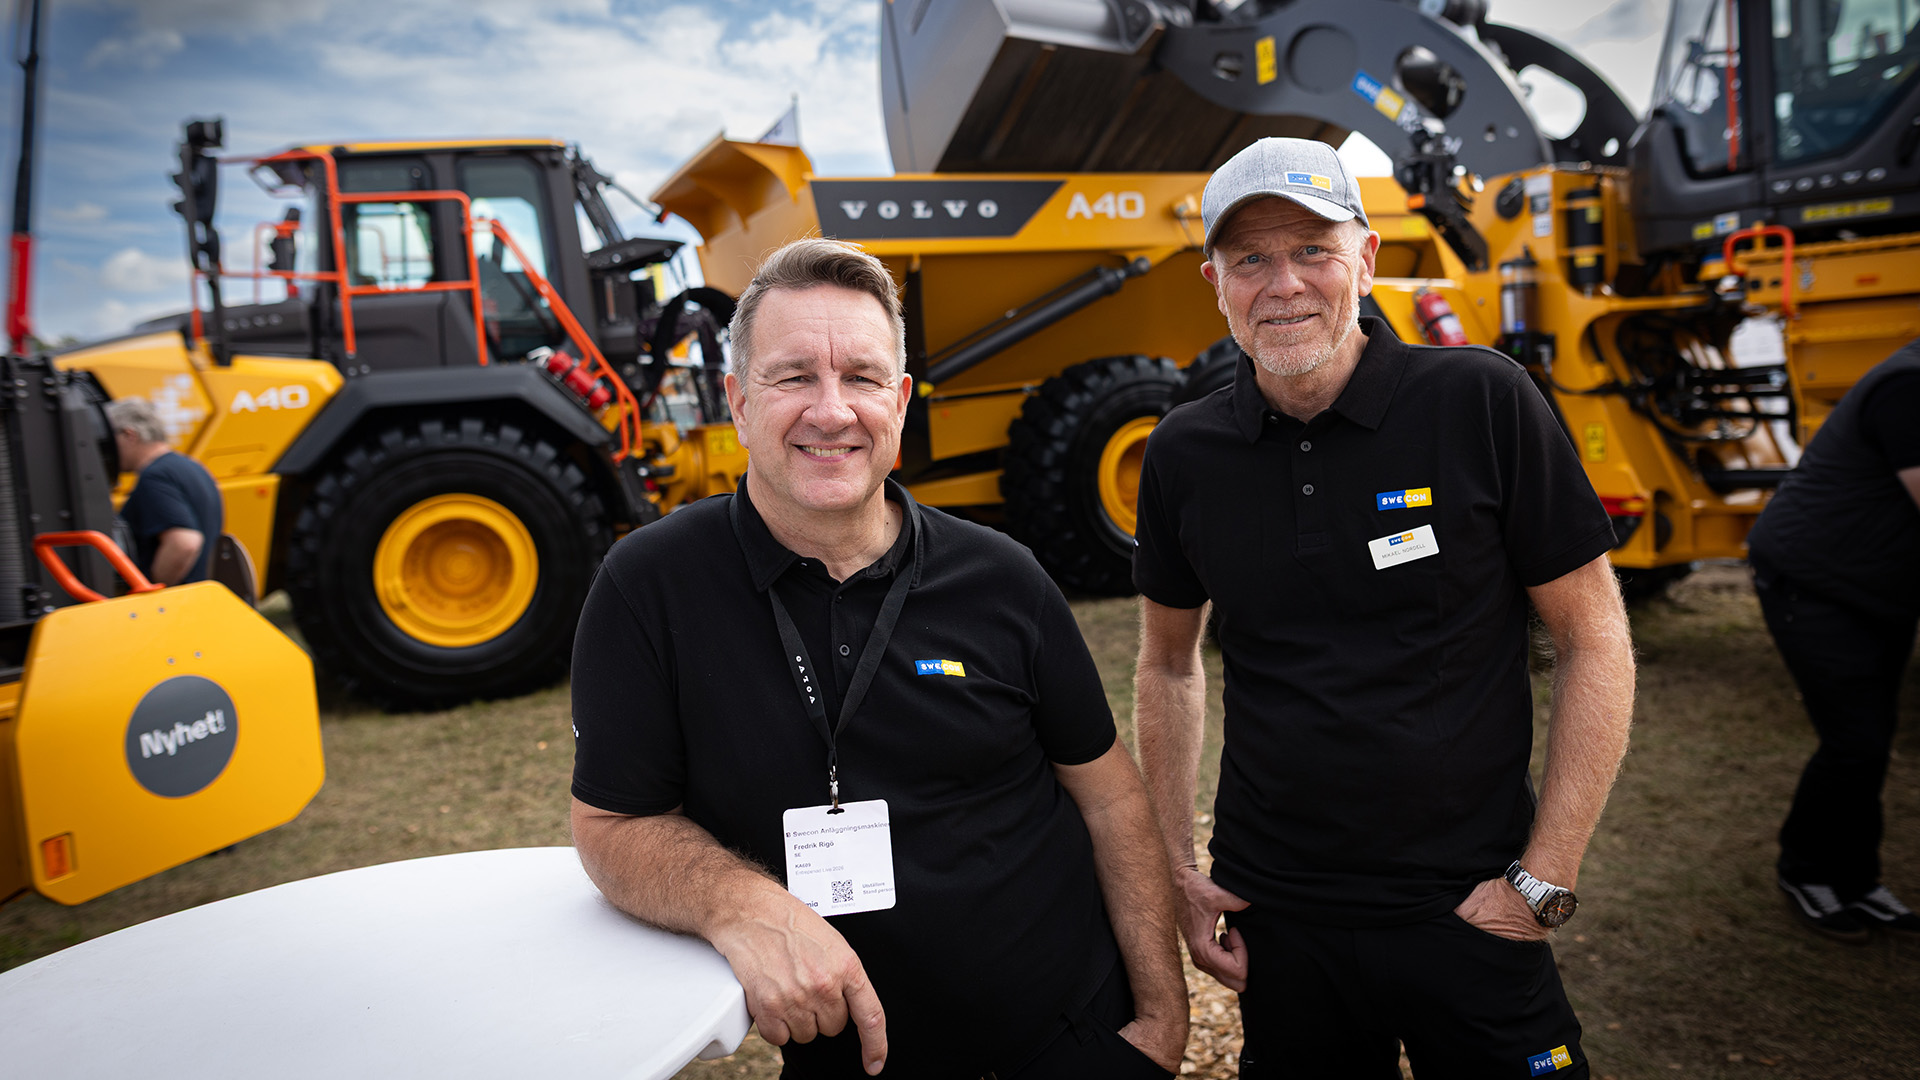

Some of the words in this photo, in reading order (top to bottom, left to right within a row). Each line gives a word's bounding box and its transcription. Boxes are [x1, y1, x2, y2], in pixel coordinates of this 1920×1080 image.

[840, 200, 998, 219] VOLVO
[1066, 191, 1145, 219] A40
[230, 385, 309, 414] A40
[1381, 493, 1427, 506] SWECON
[1390, 534, 1412, 544] SWECON
[1381, 551, 1401, 559] MIKAEL
[1402, 544, 1426, 554] NORDELL
[920, 662, 961, 672] SWECON
[795, 655, 816, 704] VOLVO
[139, 708, 226, 758] Nyhet!
[793, 828, 819, 838] Swecon
[793, 842, 817, 851] Fredrik
[1534, 1051, 1568, 1070] SWECON
